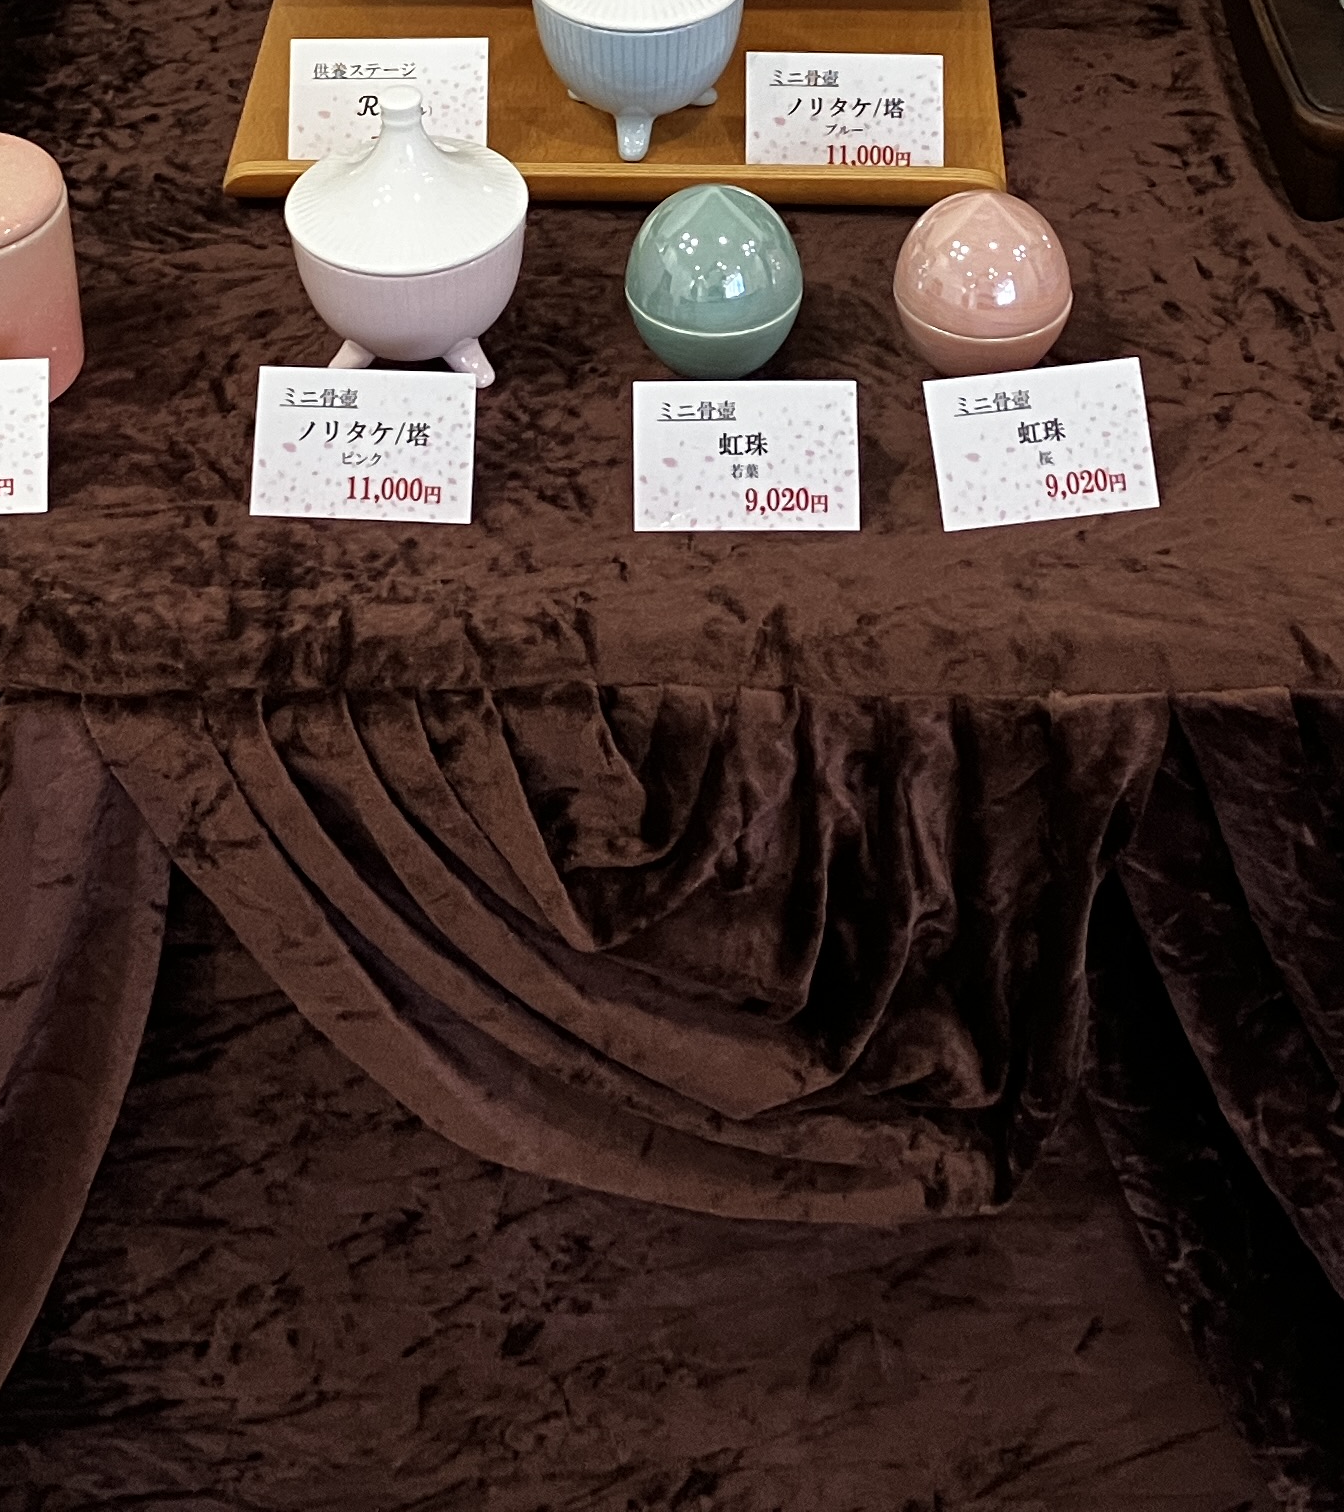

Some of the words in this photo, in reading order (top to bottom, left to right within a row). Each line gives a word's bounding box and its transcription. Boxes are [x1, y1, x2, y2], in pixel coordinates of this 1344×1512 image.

[313, 62, 417, 79] 供養ステージ
[787, 97, 904, 119] ノリタケ/塔
[826, 124, 864, 136] ブルー
[827, 145, 911, 167] 11,000円
[298, 420, 431, 447] ノリタケ/塔
[1017, 418, 1067, 444] 虹珠
[719, 432, 768, 456] 虹珠
[342, 452, 382, 466] ピンク
[731, 464, 759, 479] 若葉
[347, 476, 442, 504] 11,000円
[1045, 468, 1127, 500] 9,020円
[745, 487, 828, 515] 9,020円
